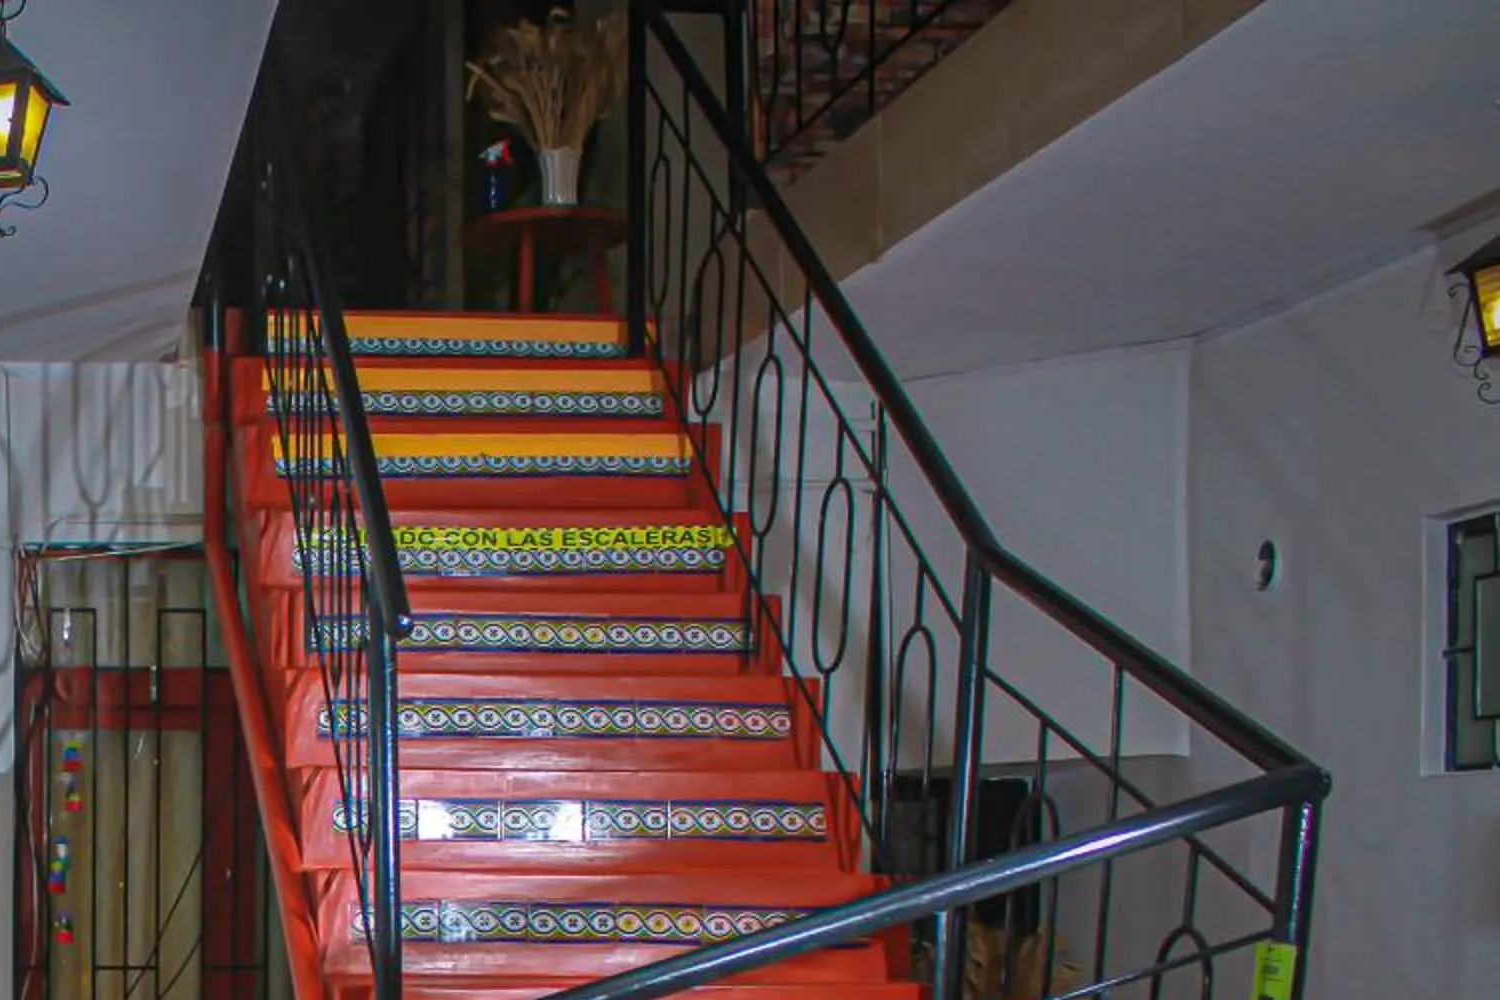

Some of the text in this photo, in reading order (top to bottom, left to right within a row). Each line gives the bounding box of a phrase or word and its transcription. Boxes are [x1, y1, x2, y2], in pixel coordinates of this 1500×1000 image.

[444, 530, 498, 547] CON
[507, 530, 553, 547] LAS
[561, 528, 712, 547] ESCALERAS
